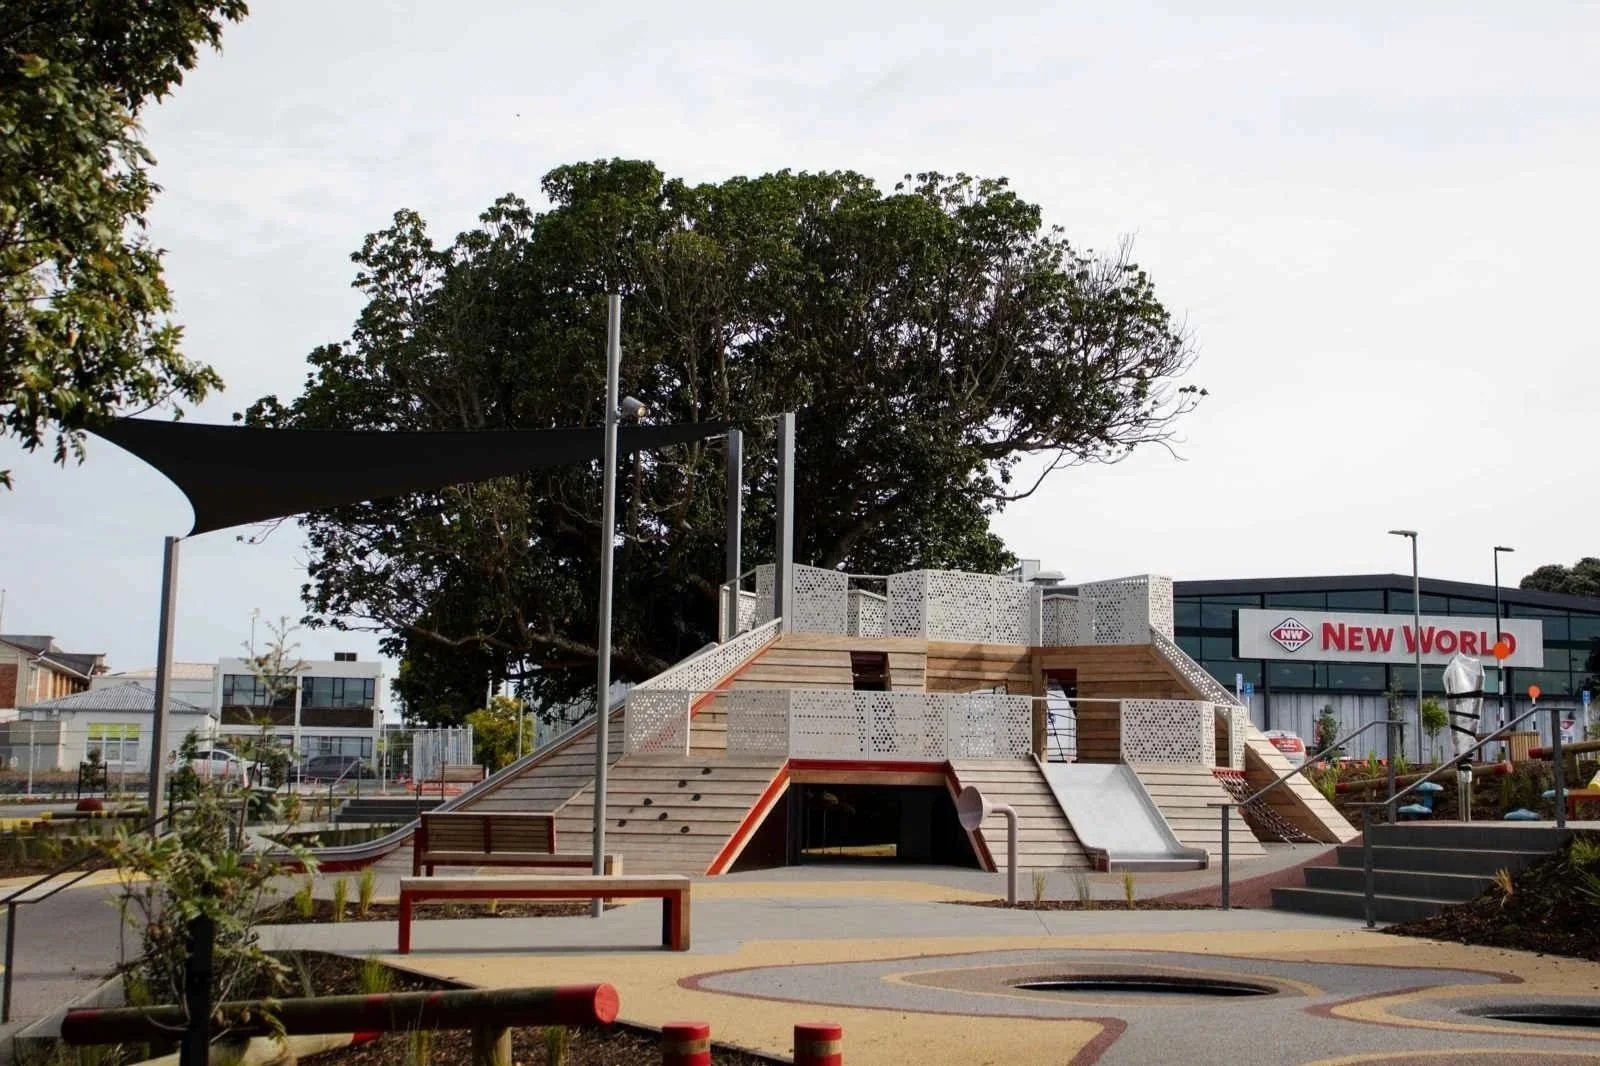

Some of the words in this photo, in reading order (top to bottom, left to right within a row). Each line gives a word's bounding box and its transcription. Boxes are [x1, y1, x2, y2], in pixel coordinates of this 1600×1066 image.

[1280, 629, 1304, 640] NW
[1322, 622, 1394, 653] NEW
[1402, 625, 1516, 656] WORLD
